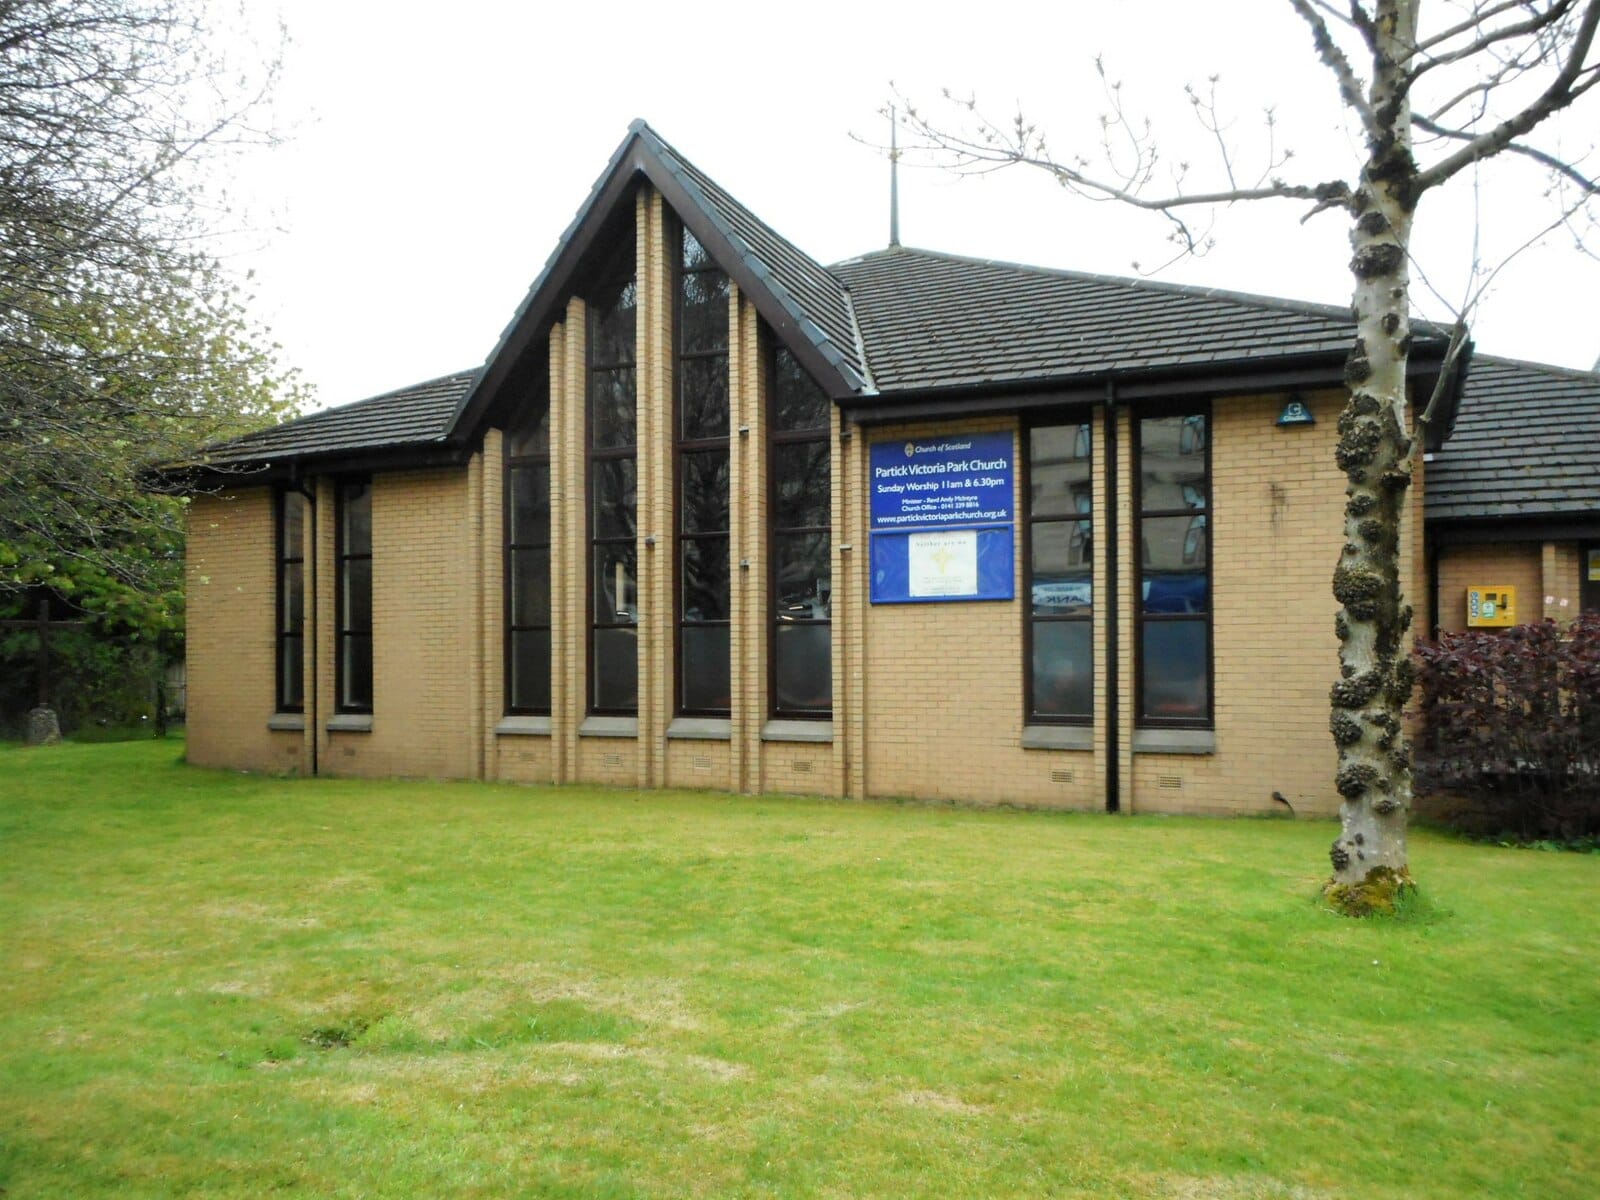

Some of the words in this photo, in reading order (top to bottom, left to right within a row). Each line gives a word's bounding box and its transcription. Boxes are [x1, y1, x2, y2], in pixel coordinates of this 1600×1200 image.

[915, 446, 936, 454] Church
[937, 444, 944, 452] of
[945, 442, 972, 451] Scotland
[876, 465, 908, 478] Partick
[908, 462, 946, 475] Victoria
[946, 460, 968, 472] Park
[970, 458, 1006, 471] Church
[877, 484, 905, 494] Sunday
[906, 482, 939, 492] Worship
[942, 480, 963, 488] 11am
[964, 478, 972, 488] &
[973, 477, 1004, 488] 6.30pm
[877, 508, 1007, 524] www.partickvictoriaparkchurch.org.uk
